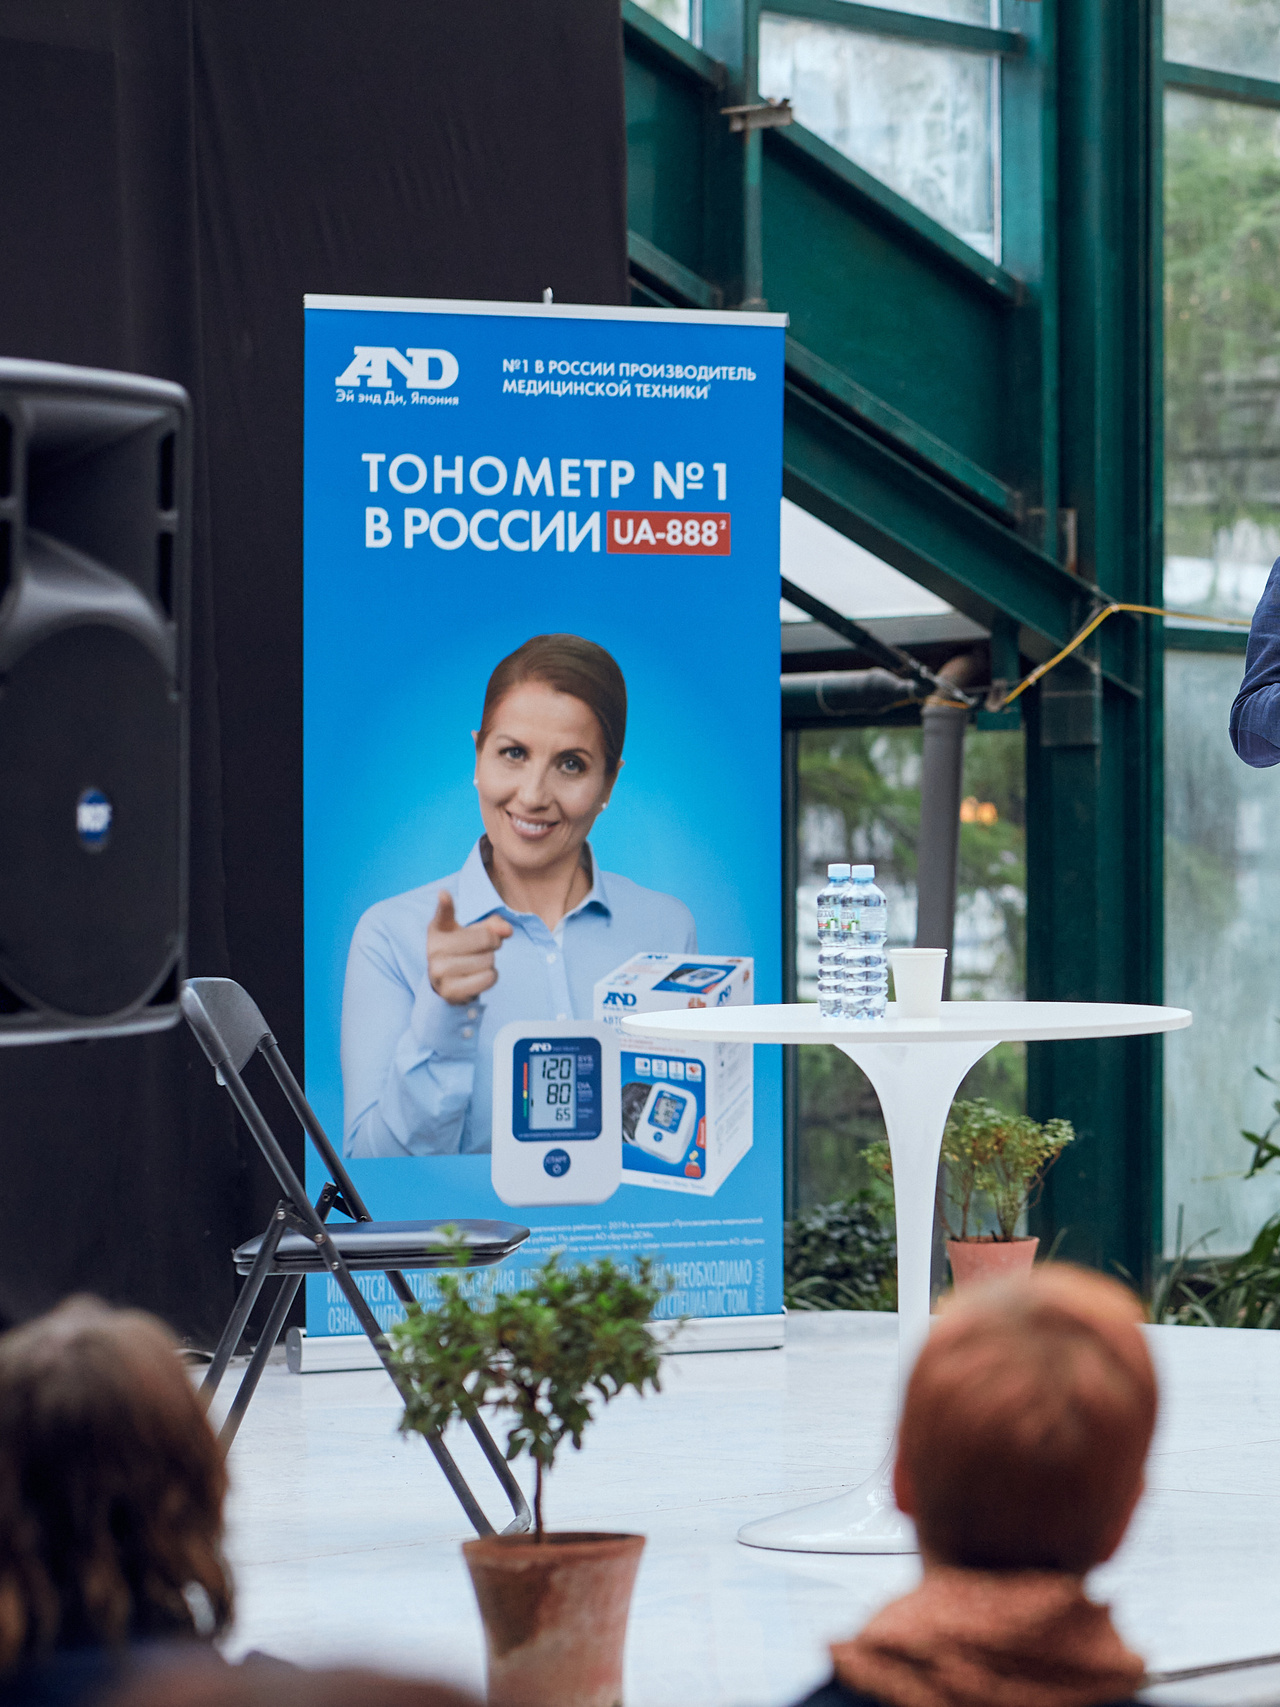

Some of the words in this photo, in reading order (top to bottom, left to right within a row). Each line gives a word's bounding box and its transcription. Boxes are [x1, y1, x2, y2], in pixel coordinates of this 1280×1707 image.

[335, 345, 459, 390] AND
[535, 359, 545, 374] В
[548, 360, 615, 376] РОССИИ
[619, 362, 757, 382] ПРОИЗВОДИТЕЛЬ
[336, 388, 354, 402] Эй
[358, 393, 382, 405] энд
[384, 390, 407, 406] Ди,
[411, 391, 459, 406] Япония
[502, 378, 631, 397] МЕДИЦИНСКОЙ
[361, 453, 635, 499] ТОНОМЕТР
[365, 506, 393, 549] В
[404, 507, 601, 553] РОССИИ
[603, 991, 637, 1007] AND
[542, 1058, 571, 1080] 120
[546, 1083, 571, 1105] 80
[555, 1107, 571, 1121] 65
[671, 1258, 752, 1289] НЕОБХОДИМО
